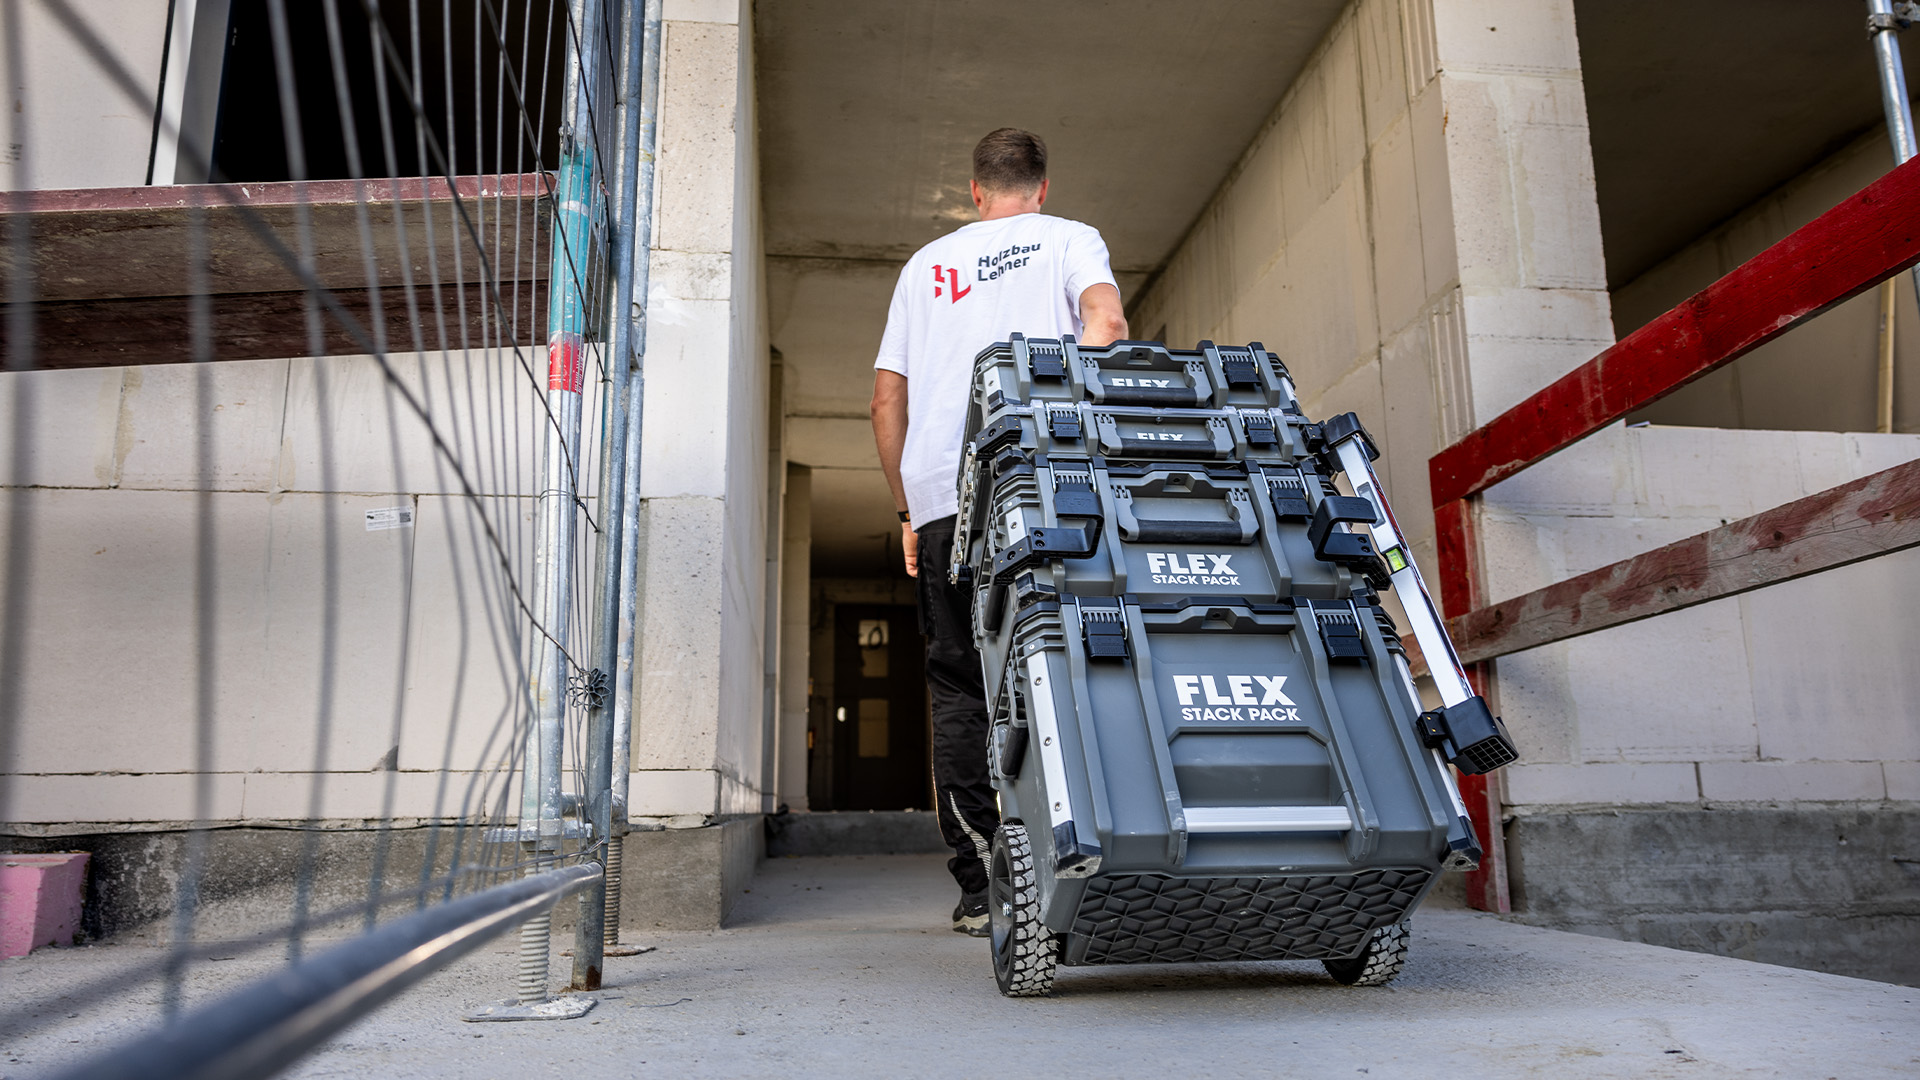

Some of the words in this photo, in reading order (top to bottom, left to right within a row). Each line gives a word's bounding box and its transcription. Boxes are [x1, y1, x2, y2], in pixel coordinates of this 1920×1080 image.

[977, 242, 1041, 268] Holzbau
[977, 256, 1030, 281] Lehner
[1111, 377, 1170, 388] FLEX
[1137, 432, 1184, 441] FLEX
[1146, 552, 1238, 575] FLEX
[1152, 574, 1199, 585] STACK
[1201, 575, 1241, 586] PACK
[1172, 674, 1297, 706] FLEX
[1181, 707, 1245, 721] STACK
[1247, 707, 1302, 721] PACK
